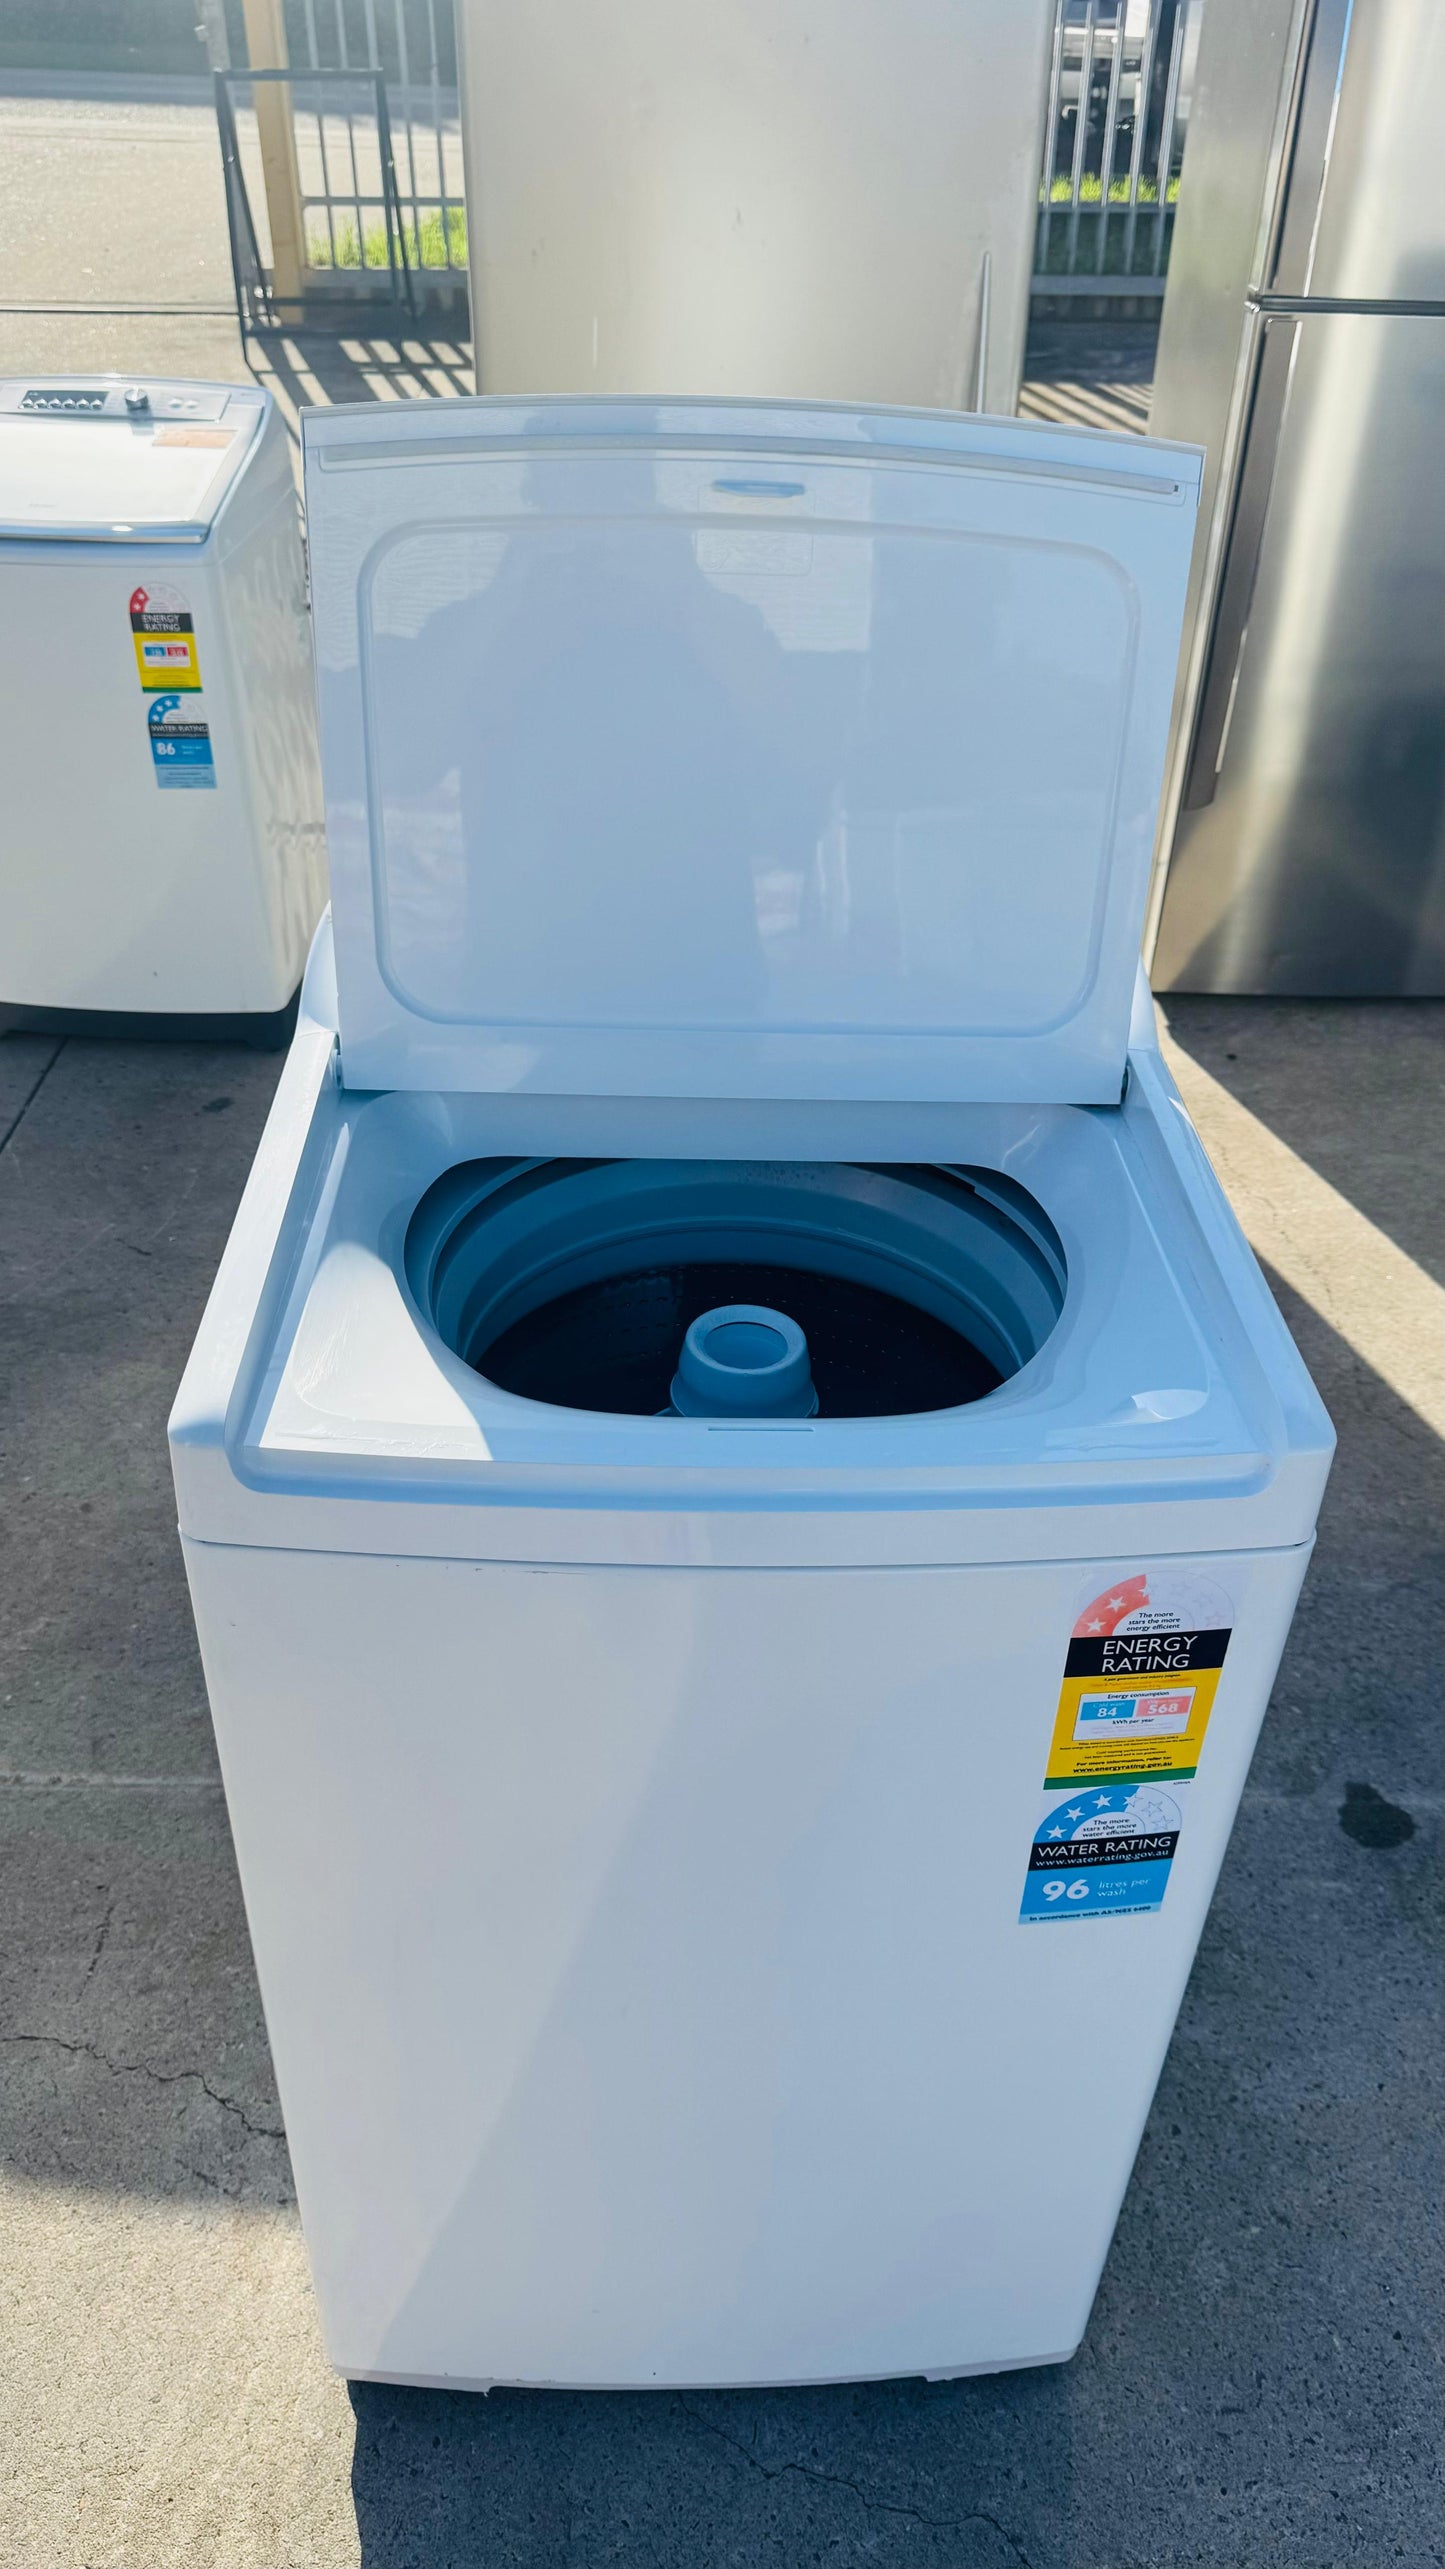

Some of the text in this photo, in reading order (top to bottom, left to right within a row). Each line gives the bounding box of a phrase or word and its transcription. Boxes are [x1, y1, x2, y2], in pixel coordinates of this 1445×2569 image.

[156, 742, 176, 755] 86
[1126, 1624, 1150, 1632] energy
[1102, 1635, 1198, 1655] ENERGY
[1101, 1654, 1190, 1673] RATING
[1097, 1707, 1117, 1718] 84
[1147, 1703, 1179, 1715] 568
[1038, 1836, 1172, 1857] WATER RATING
[1035, 1849, 1169, 1867] www.waterrating.gov.au
[1042, 1878, 1150, 1902] 96 litres per
[1097, 1888, 1127, 1897] wash
